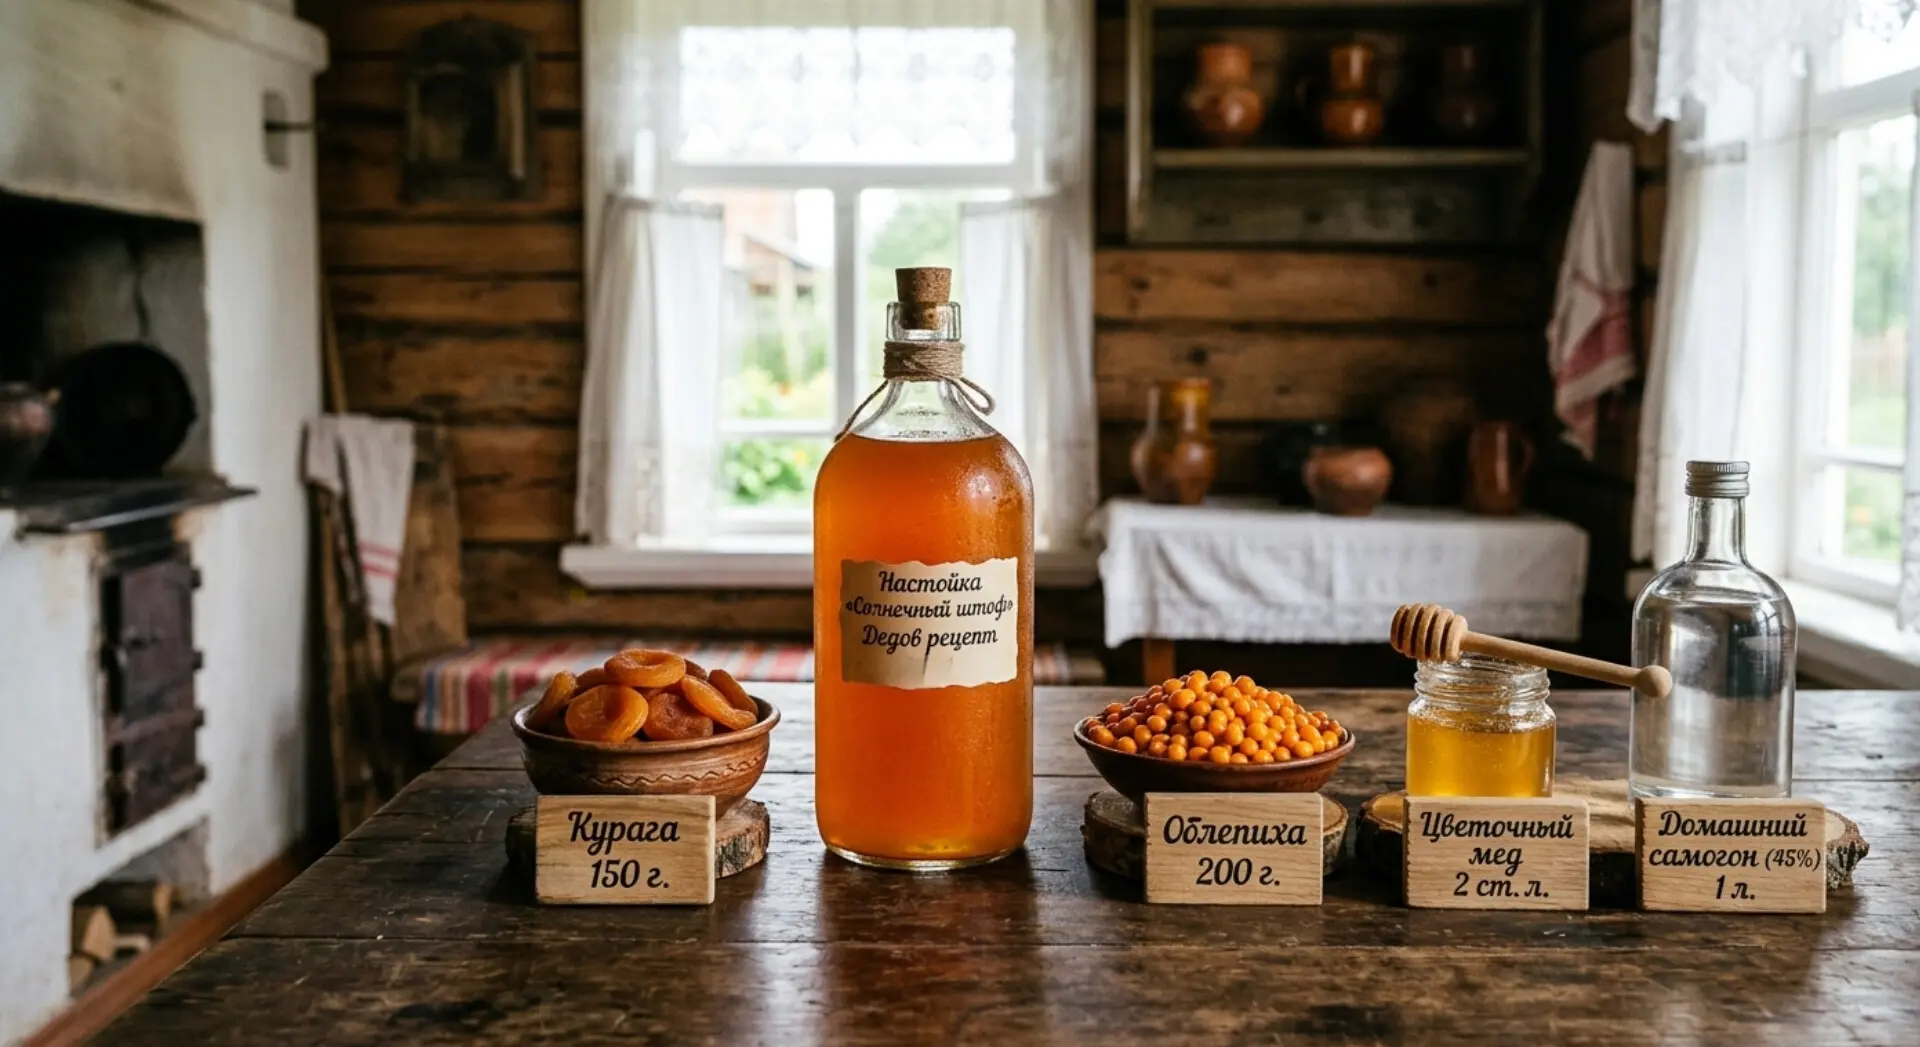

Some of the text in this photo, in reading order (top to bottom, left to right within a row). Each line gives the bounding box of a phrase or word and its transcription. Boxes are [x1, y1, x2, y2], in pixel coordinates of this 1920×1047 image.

[878, 570, 982, 592] Настойка
[862, 624, 998, 655] Дедов рецепт
[568, 811, 681, 856] Курага
[1163, 814, 1307, 846] Облепиха
[1420, 811, 1574, 843] Цветочный
[1658, 810, 1808, 837] Домашний
[591, 859, 670, 889] 150 г.
[1196, 857, 1281, 886] 200 г.
[1468, 847, 1524, 877] мед
[1649, 848, 1821, 872] самогон (45%)
[1453, 871, 1549, 898] 2 ст. л.
[1715, 874, 1756, 900] 1 л.
